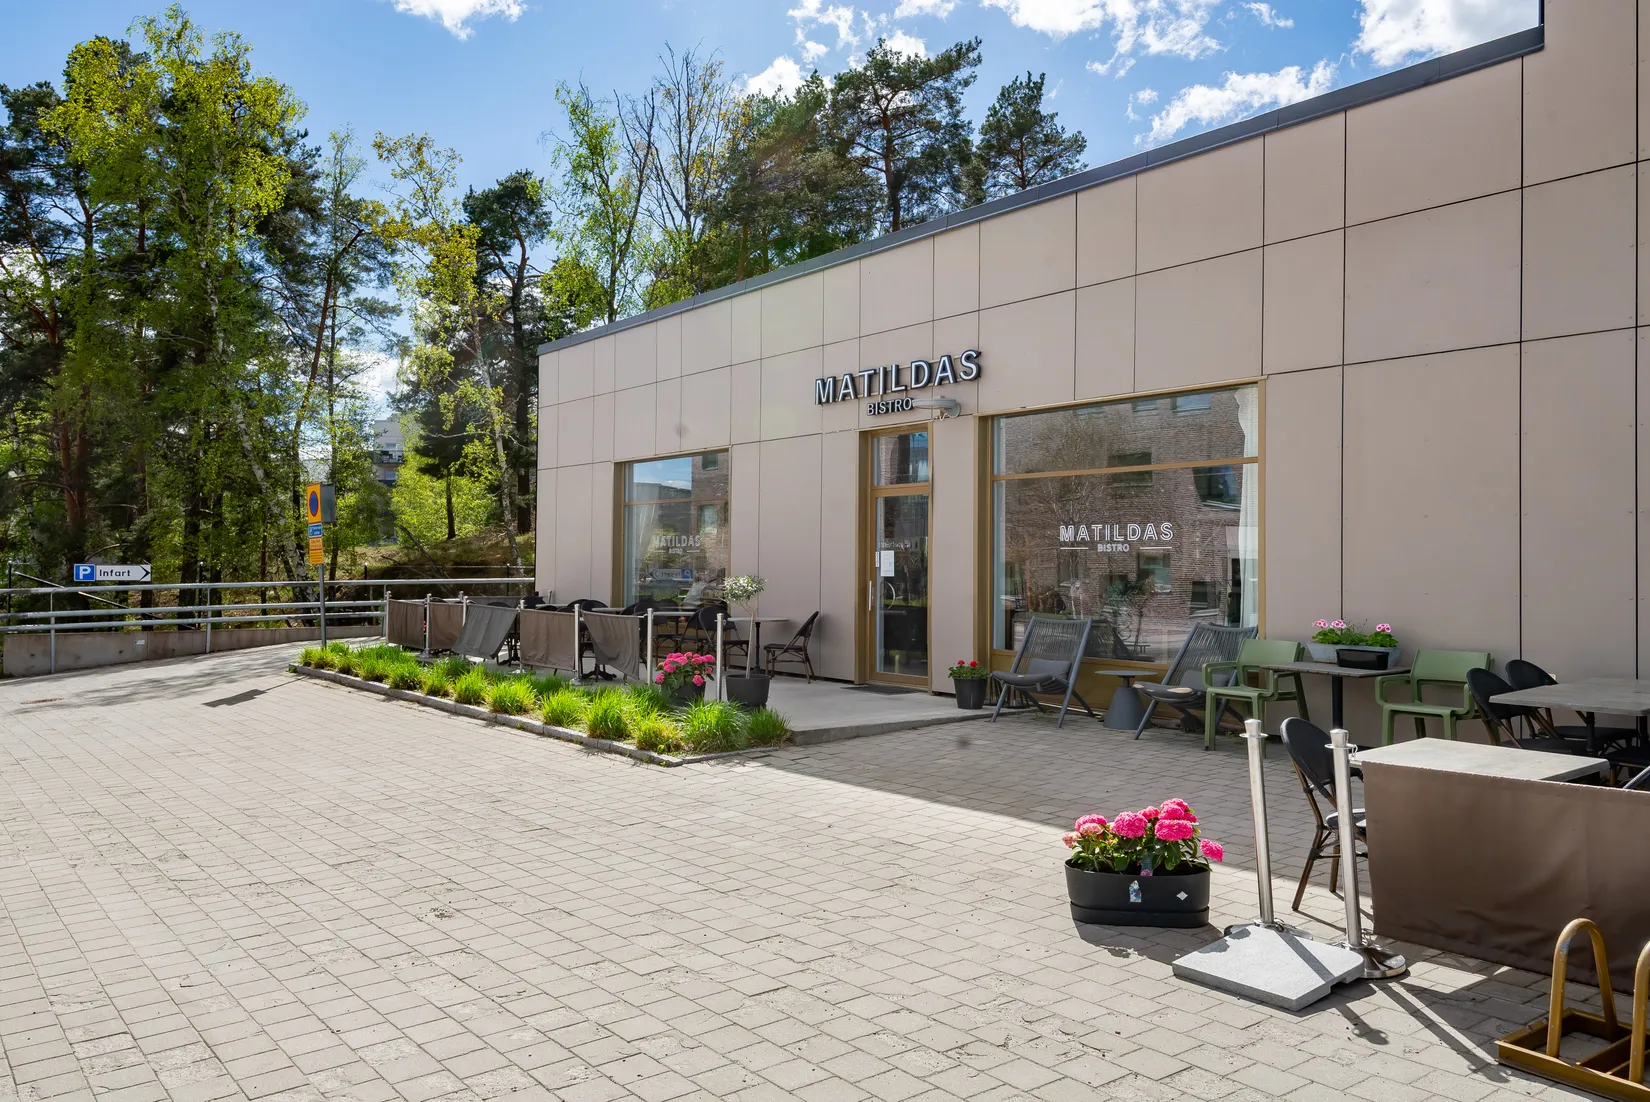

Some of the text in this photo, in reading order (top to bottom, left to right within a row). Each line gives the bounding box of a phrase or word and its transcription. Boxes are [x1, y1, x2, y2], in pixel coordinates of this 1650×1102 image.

[815, 349, 982, 405] MATILDAS
[867, 397, 914, 416] BISTRO
[1059, 522, 1173, 542] MATILDAS
[1097, 543, 1130, 552] BISTRO
[79, 566, 131, 580] P Infart
